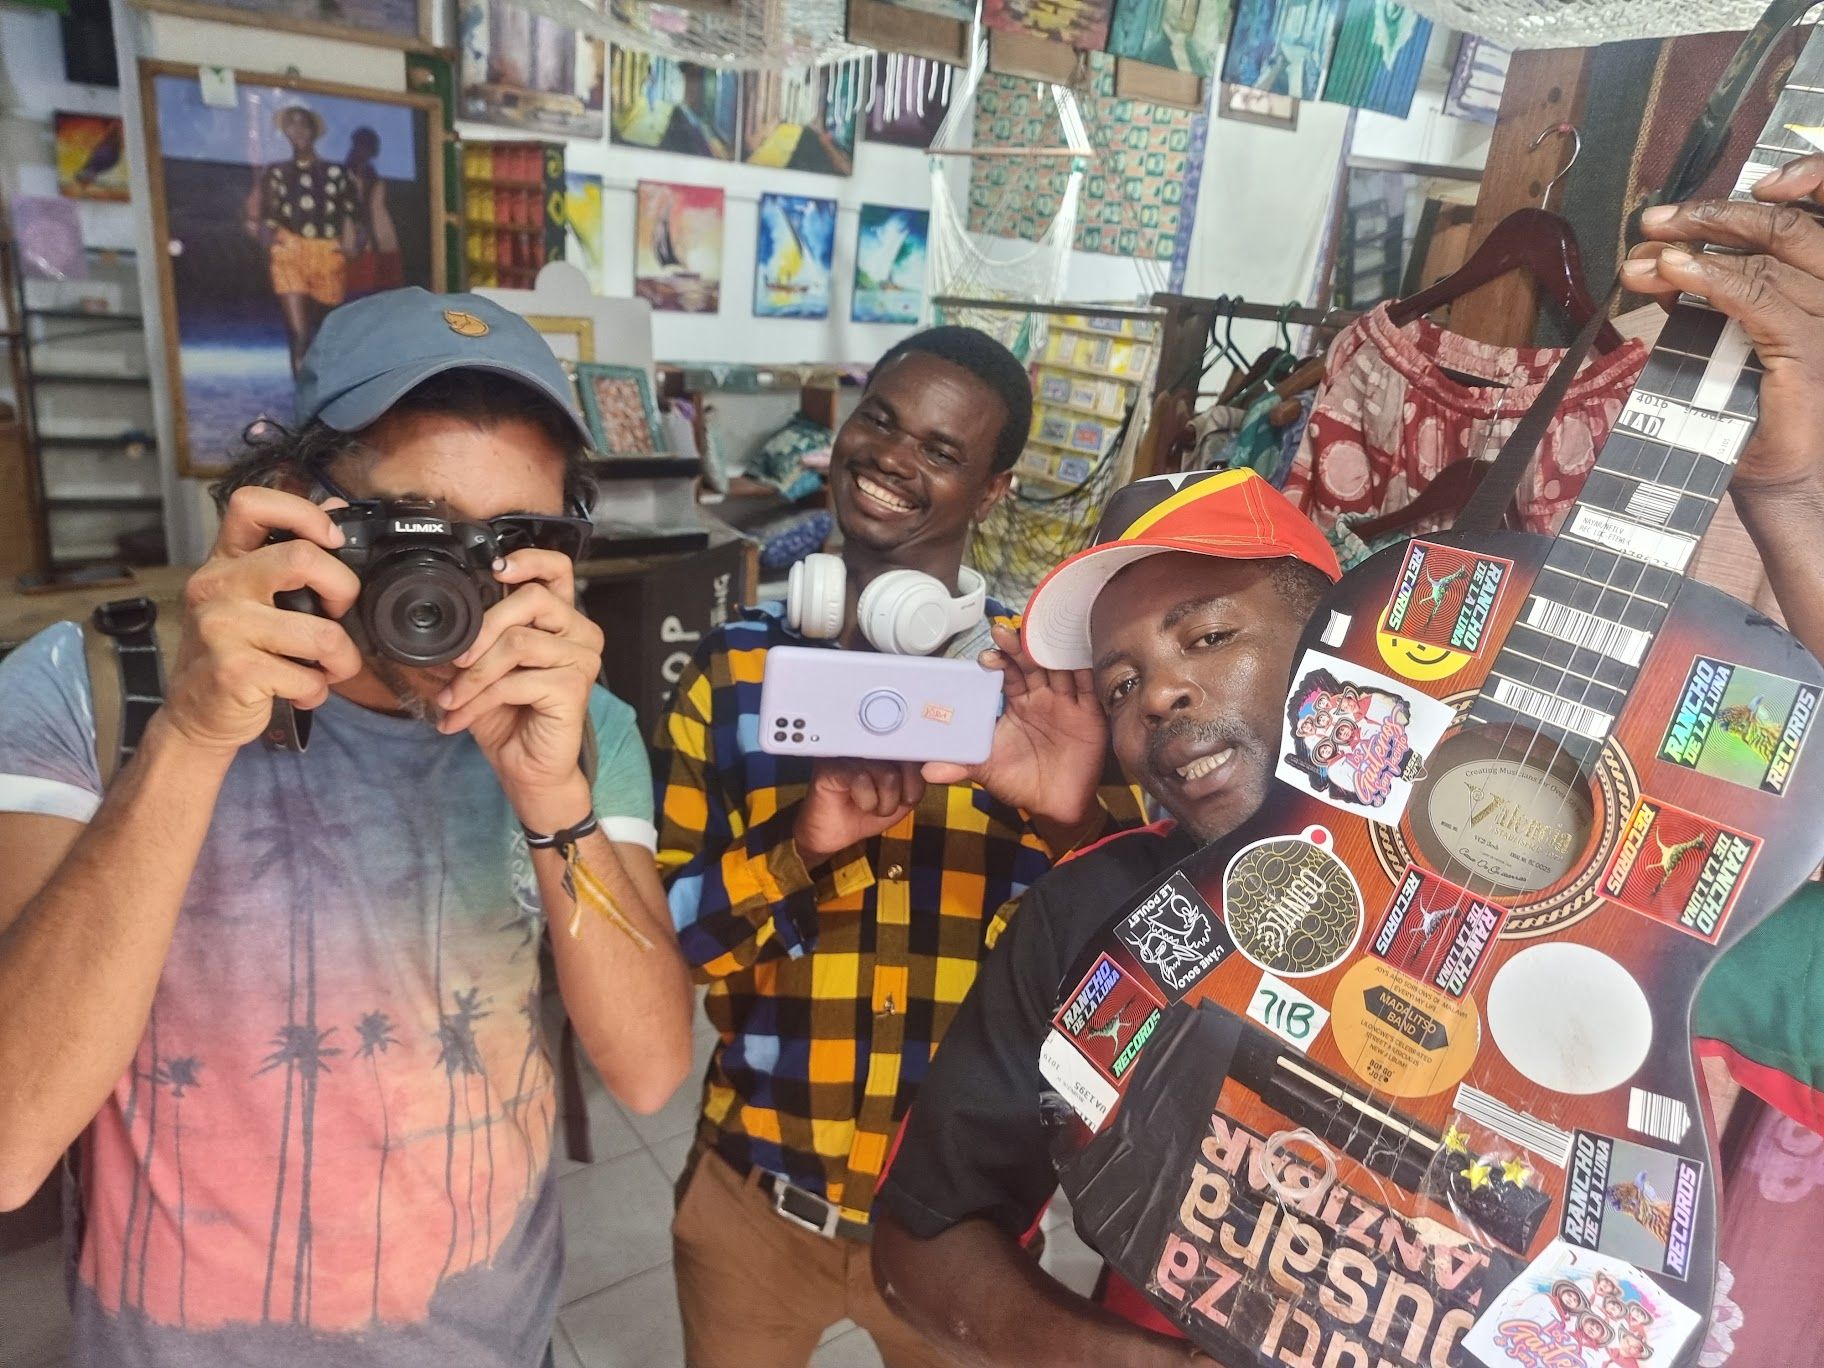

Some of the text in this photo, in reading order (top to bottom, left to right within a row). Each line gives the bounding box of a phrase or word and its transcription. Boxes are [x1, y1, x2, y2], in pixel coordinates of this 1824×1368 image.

[1621, 410, 1664, 439] IAD
[1636, 394, 1669, 409] 4016
[394, 521, 444, 533] LUMIX
[474, 535, 485, 543] G
[1389, 546, 1425, 631] RECORDS
[1450, 561, 1488, 647] DE LA LUNA
[1463, 561, 1503, 651] RANCHO
[1664, 660, 1714, 763] RANCHO
[1683, 666, 1731, 765] DE LA LUNA
[1766, 688, 1815, 791] RECORDS
[1346, 750, 1364, 769] Los
[1375, 771, 1392, 796] San
[1385, 735, 1408, 776] Jacinto
[1465, 767, 1498, 778] Creating
[1499, 767, 1538, 783] Musicians
[1606, 803, 1656, 896] RECORDS
[1680, 832, 1731, 927] DE LA LUNA
[1696, 836, 1750, 935] RANCHO
[1128, 883, 1173, 929] LE POULET
[1376, 871, 1421, 956] RECORDS
[1435, 902, 1482, 988] DE LA LUNA
[1178, 965, 1201, 988] SOLO
[1449, 906, 1498, 996] RANCHO
[1062, 960, 1111, 1031] RANCHO
[1072, 969, 1120, 1036] DE LA LUNA
[1379, 992, 1437, 1034] MADALITSO
[1387, 1011, 1416, 1035] BAND
[1113, 1008, 1161, 1078] RECORDS
[1565, 1133, 1595, 1245] RANCHO
[1584, 1139, 1610, 1247] DE LA LUNA
[1666, 1163, 1696, 1275] RECORDS
[1157, 1232, 1242, 1327] za
